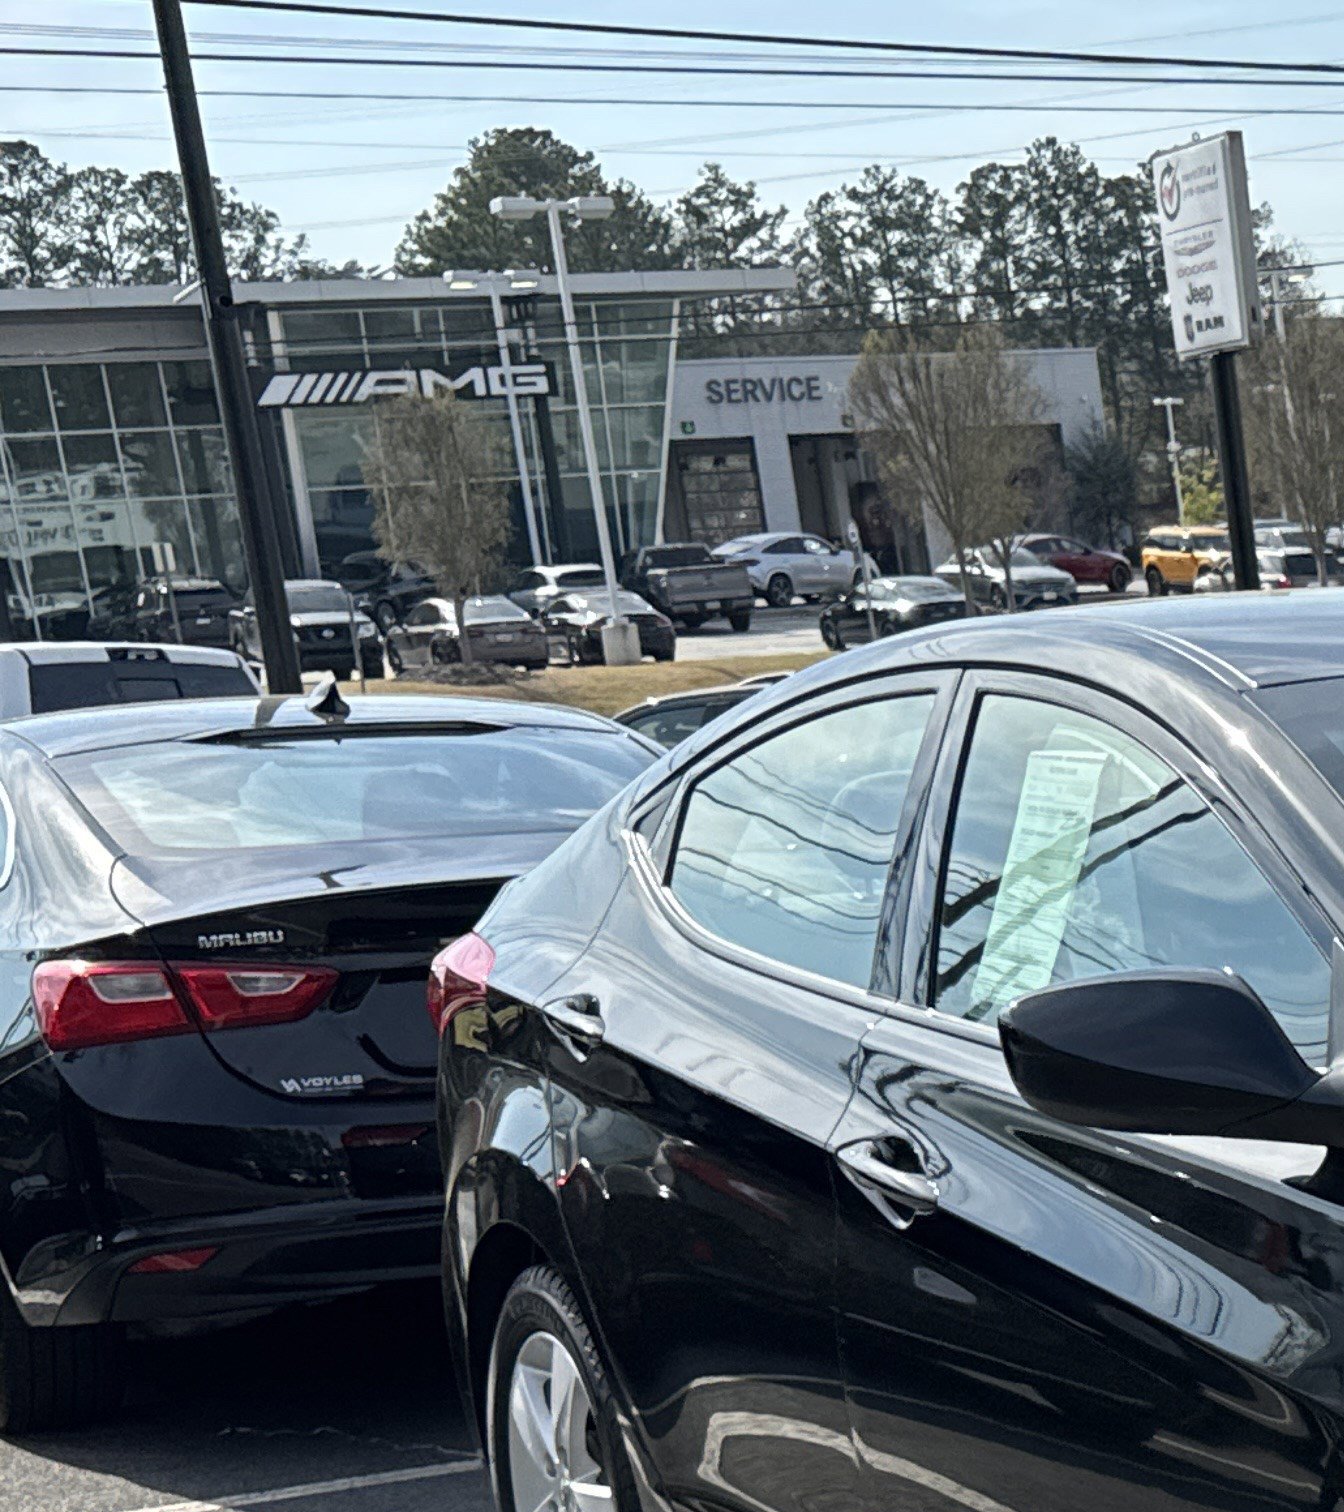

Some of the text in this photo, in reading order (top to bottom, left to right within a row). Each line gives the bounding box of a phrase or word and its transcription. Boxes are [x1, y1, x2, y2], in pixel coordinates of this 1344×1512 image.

[1186, 282, 1214, 306] Jeep
[1196, 316, 1224, 332] RAM
[352, 364, 550, 403] AMG
[705, 375, 823, 404] SERVICE
[198, 930, 284, 949] MALIBU
[301, 1074, 364, 1088] VOYLES
